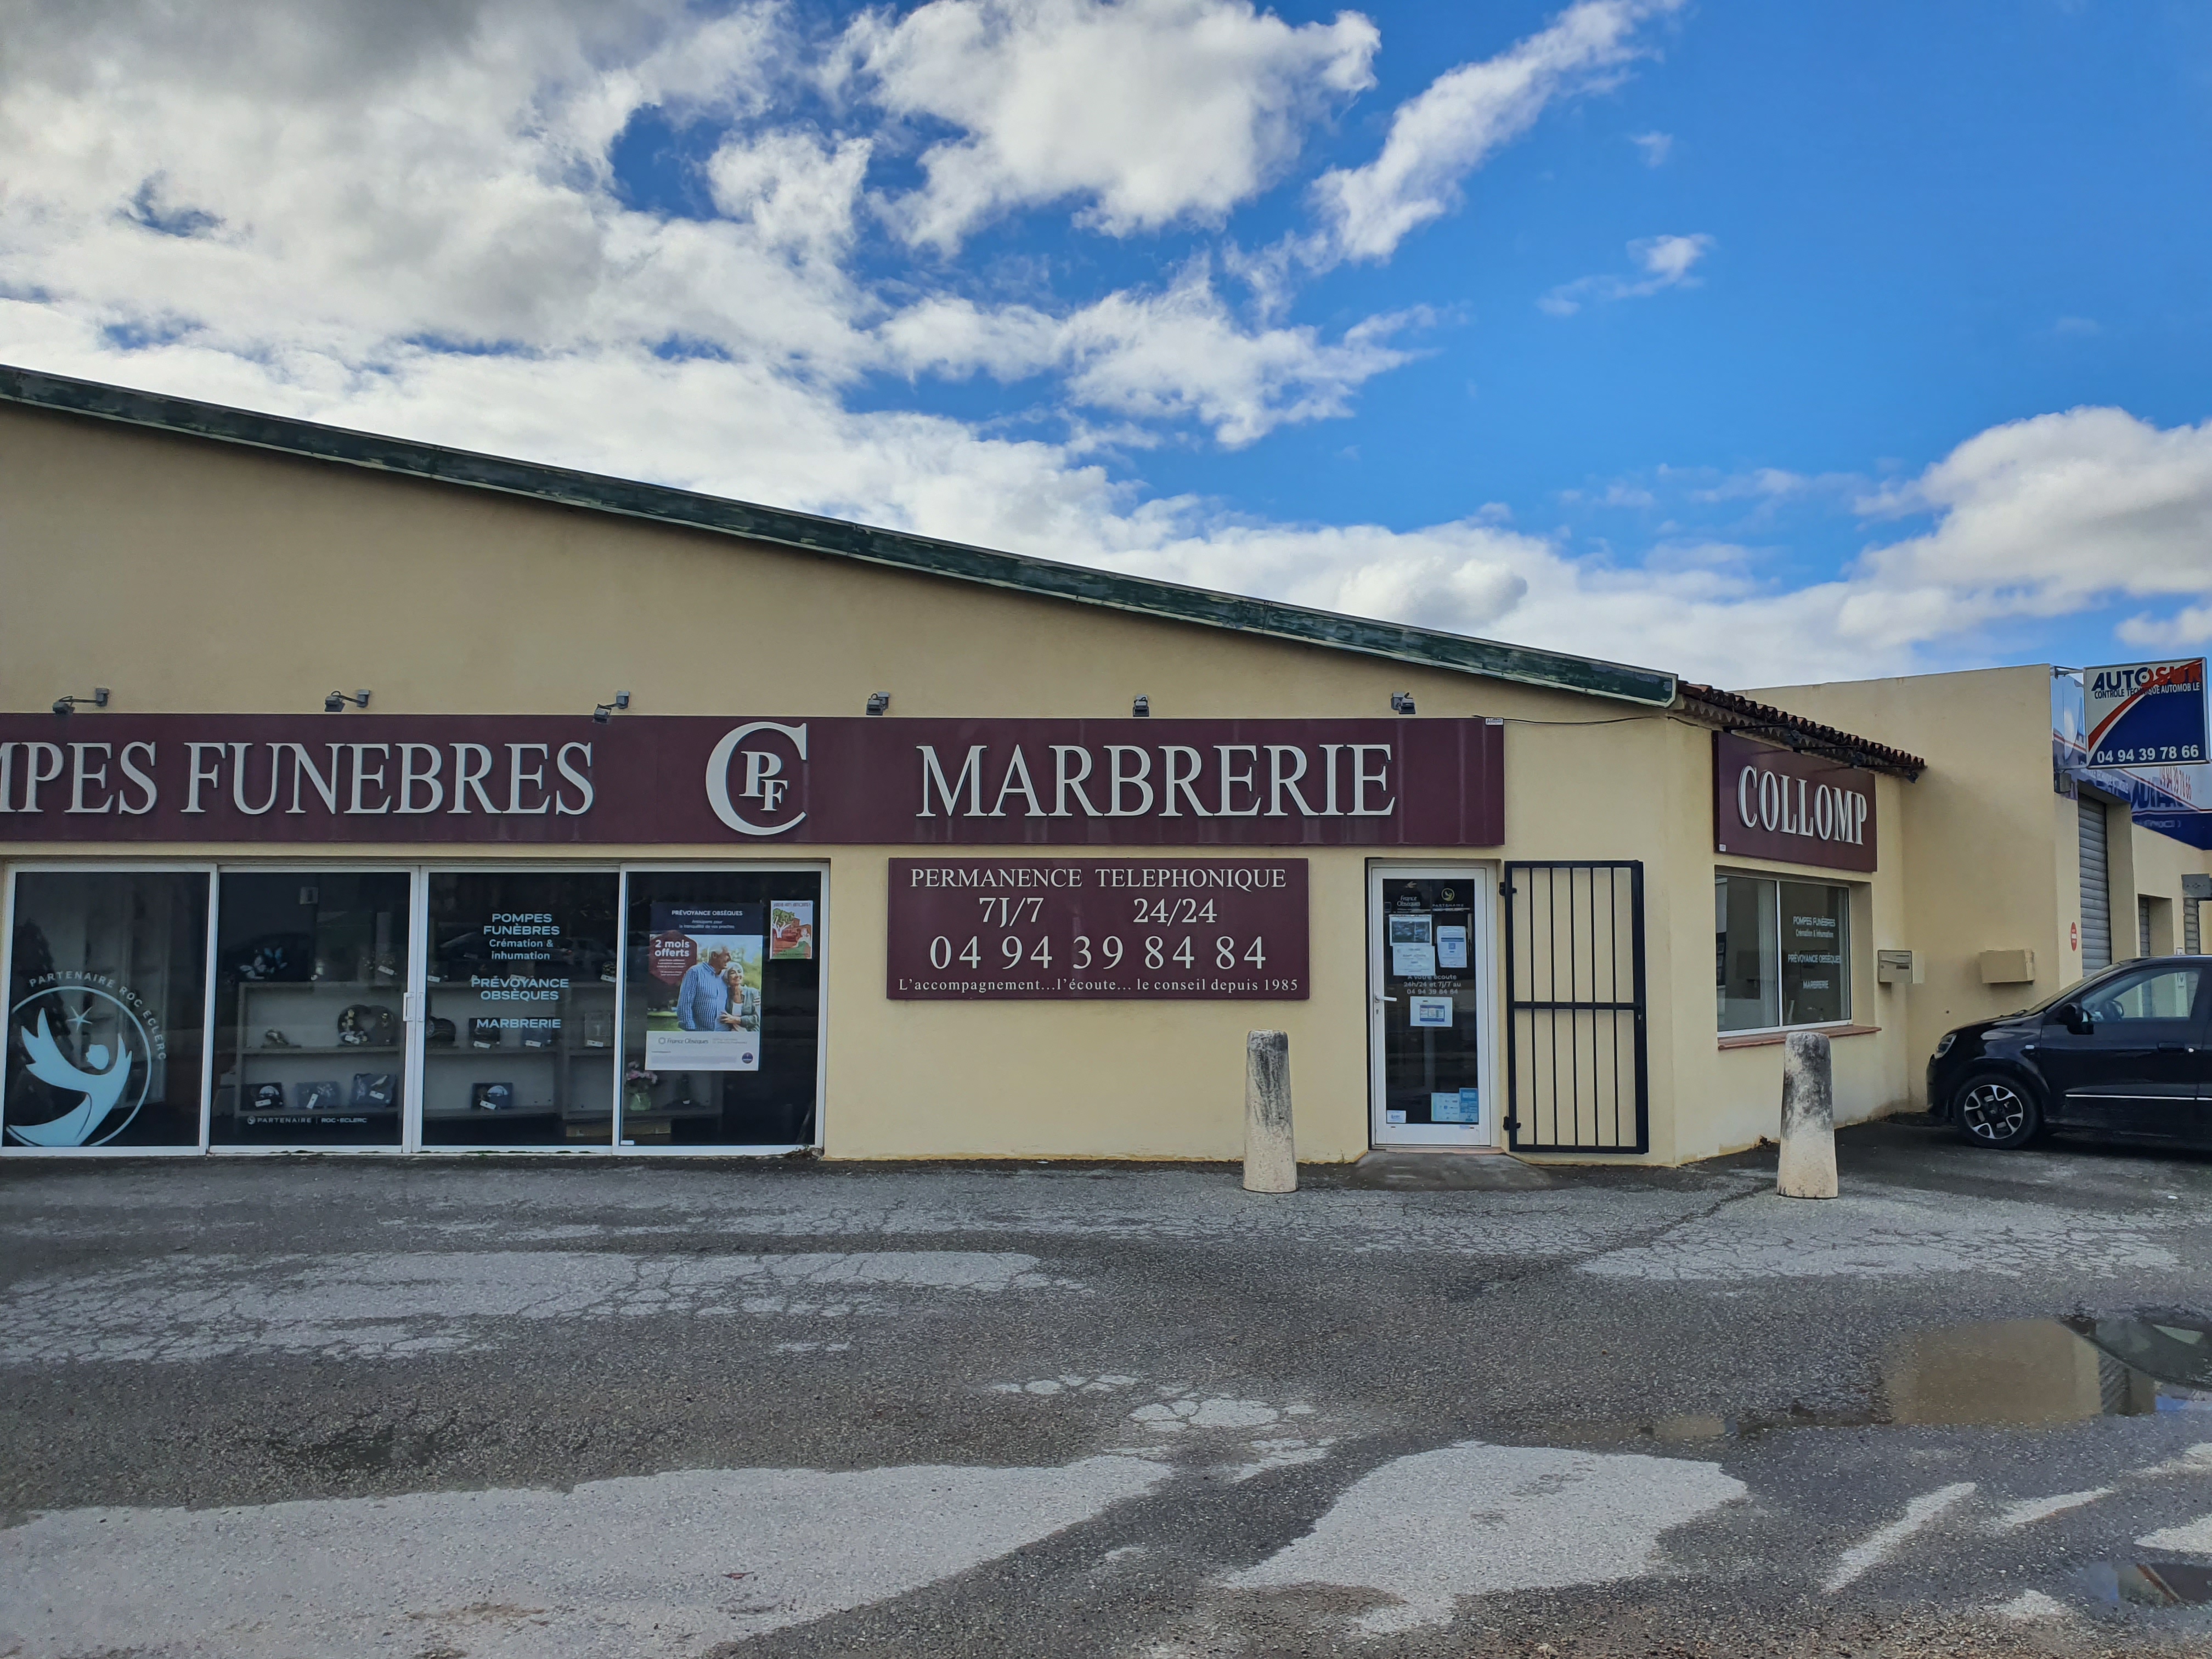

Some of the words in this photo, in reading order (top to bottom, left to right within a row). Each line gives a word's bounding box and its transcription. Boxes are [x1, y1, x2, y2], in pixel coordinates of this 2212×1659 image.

[2097, 751, 2114, 763] 04
[2118, 749, 2135, 762] 94
[2138, 748, 2155, 761] 39
[2160, 746, 2177, 759] 78
[2181, 744, 2199, 758] 66
[180, 742, 595, 815] FUNEBRES
[916, 743, 1396, 817] MARBRERIE
[1738, 765, 1867, 845] COLLOMP
[910, 868, 1082, 888] PERMANENCE
[1095, 868, 1286, 892] TELEPHONIQUE
[492, 913, 552, 923] POMPES
[979, 897, 1044, 928] 7J/7
[1133, 898, 1217, 927] 24/24
[1793, 916, 1812, 926] POMPES
[483, 923, 560, 935] FUNÈBRES
[489, 938, 543, 947] Crémation
[655, 940, 662, 948] 2
[664, 940, 690, 948] mois
[654, 948, 690, 957] offerts
[930, 935, 981, 969] 04
[1002, 935, 1053, 969] 94
[1073, 935, 1124, 969] 39
[1145, 935, 1194, 969] 84
[1216, 935, 1266, 969] 84
[1788, 952, 1818, 963] PRÉVOYANCE
[471, 975, 569, 988] PRÉVOYANCE
[1137, 979, 1149, 990] le
[1154, 979, 1206, 990] conseil
[1211, 979, 1258, 993] depuis
[1264, 979, 1298, 991] 1985
[481, 988, 558, 1002] OBSÈQUES
[29, 970, 115, 988] PARTENAIRE
[119, 986, 143, 1007] ROC
[143, 1010, 167, 1060] ECLERC
[477, 1018, 561, 1029] MARBRERIE
